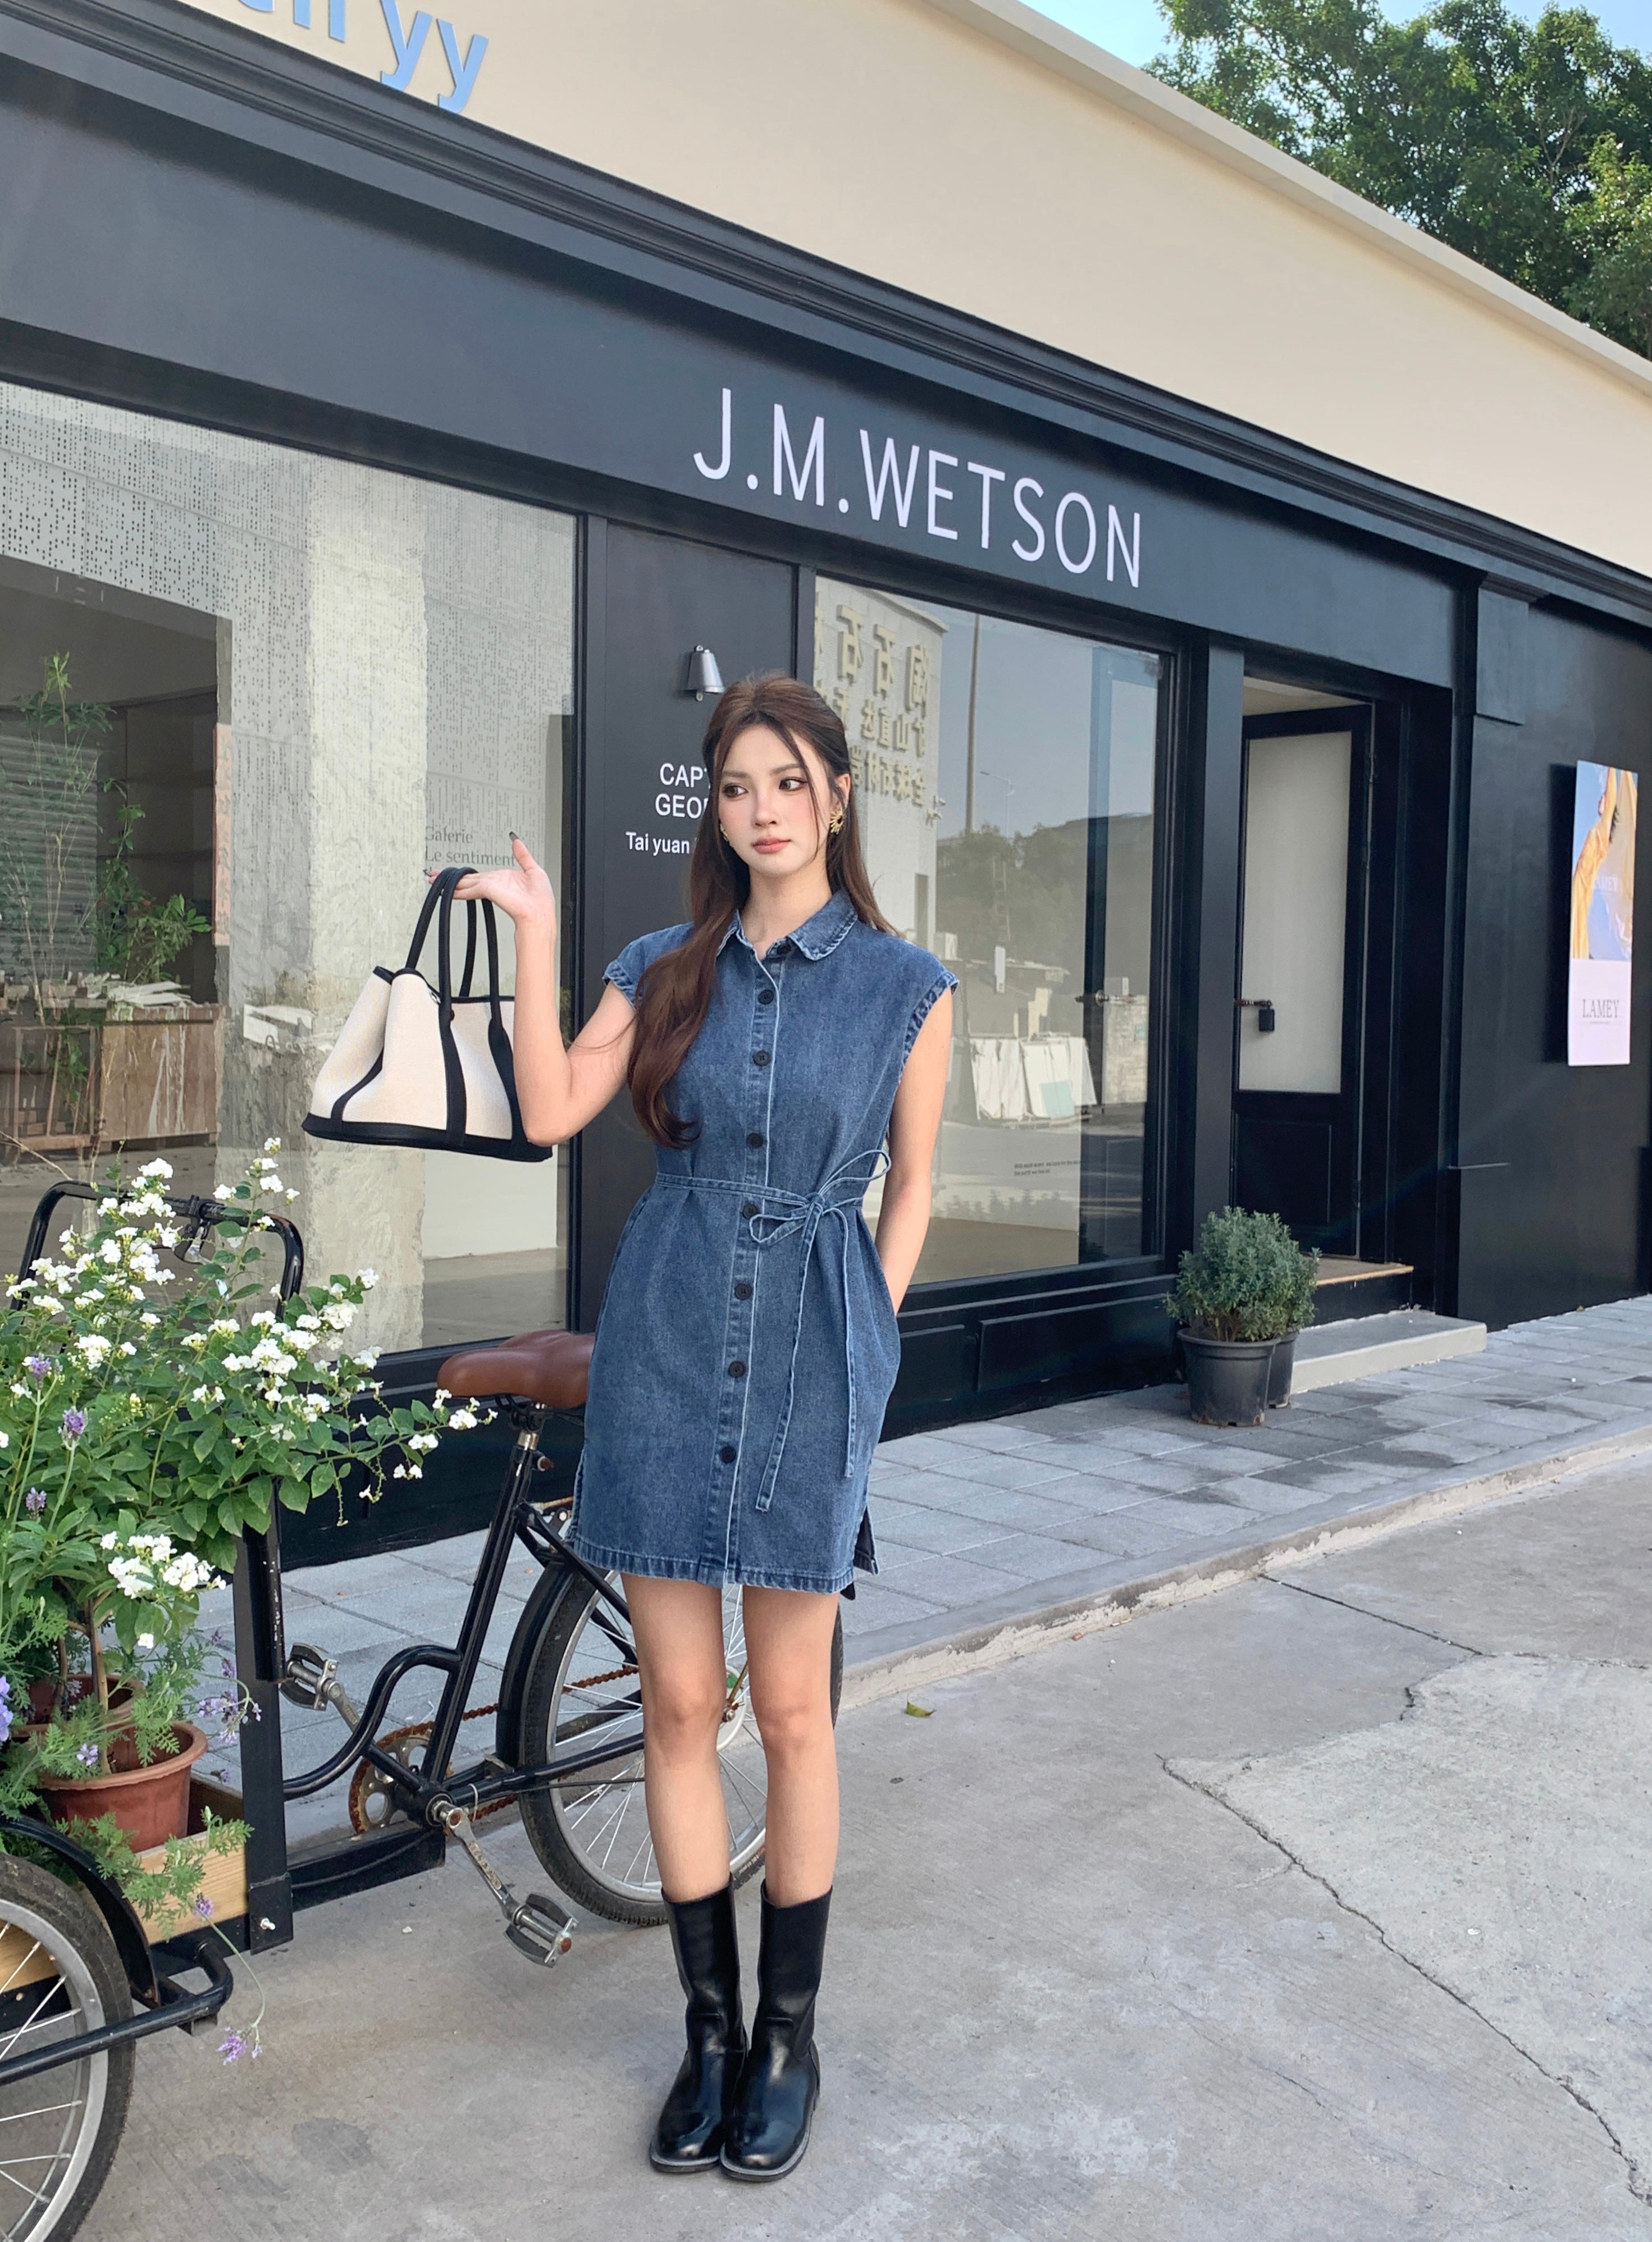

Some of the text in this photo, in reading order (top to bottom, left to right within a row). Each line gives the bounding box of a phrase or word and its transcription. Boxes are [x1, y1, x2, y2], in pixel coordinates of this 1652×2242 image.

[693, 387, 1140, 588] J.M.WETSON
[659, 762, 711, 788] CAP
[625, 831, 690, 856] Tai yuan
[425, 846, 515, 867] Le sentiment
[1582, 999, 1619, 1019] LAMEY
